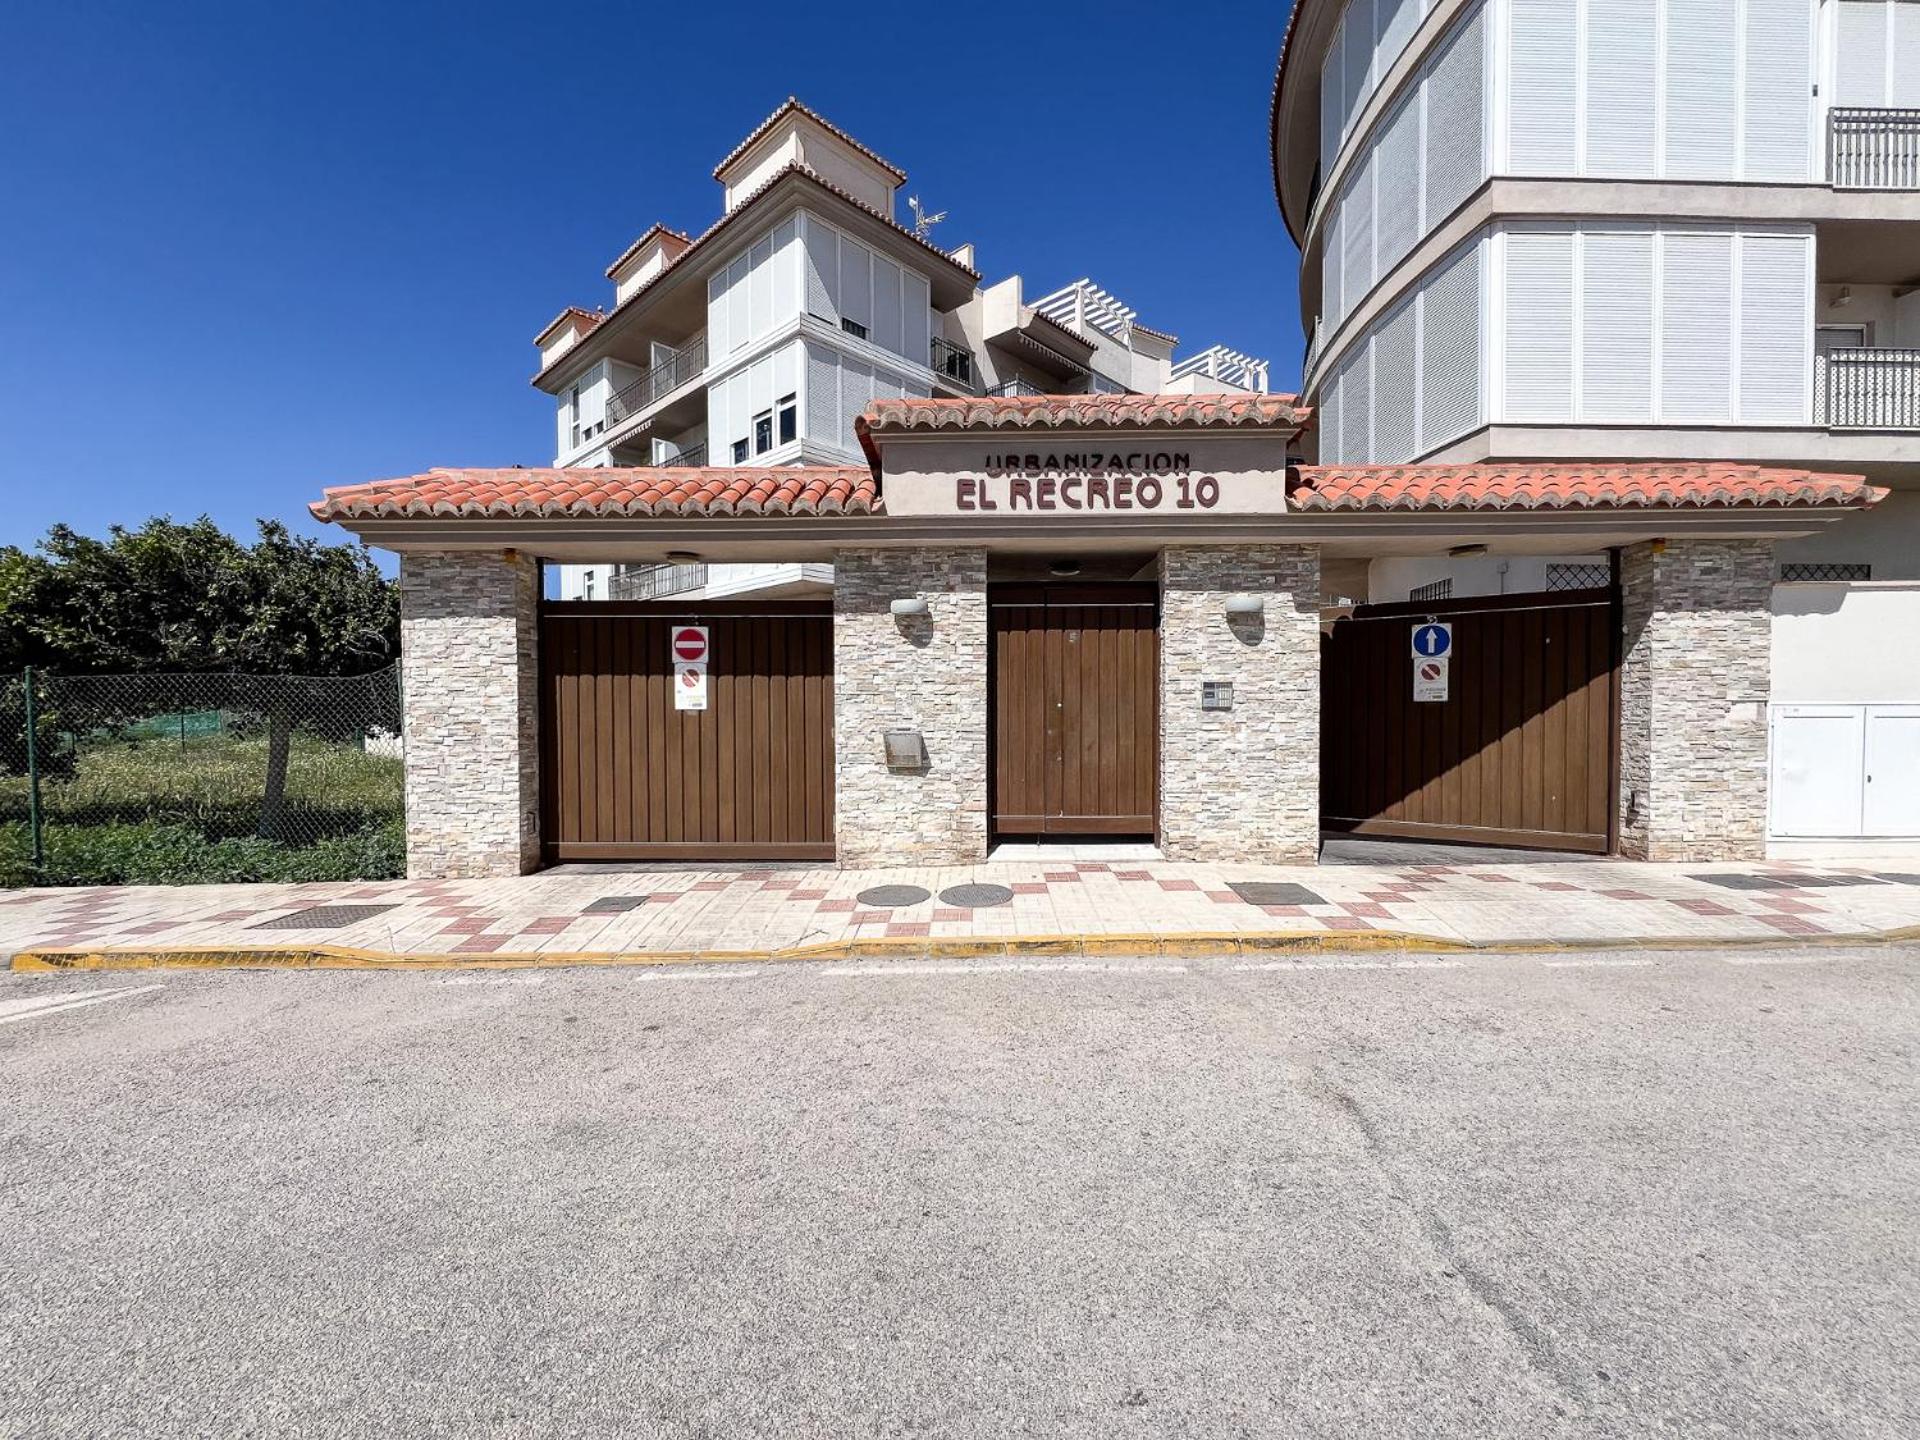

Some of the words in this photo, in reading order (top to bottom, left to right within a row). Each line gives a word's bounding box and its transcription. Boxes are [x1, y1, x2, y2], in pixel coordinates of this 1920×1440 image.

[985, 453, 1190, 478] URBANIZACION
[957, 478, 997, 510] EL
[1009, 477, 1163, 509] RECREO
[1176, 475, 1220, 508] 10
